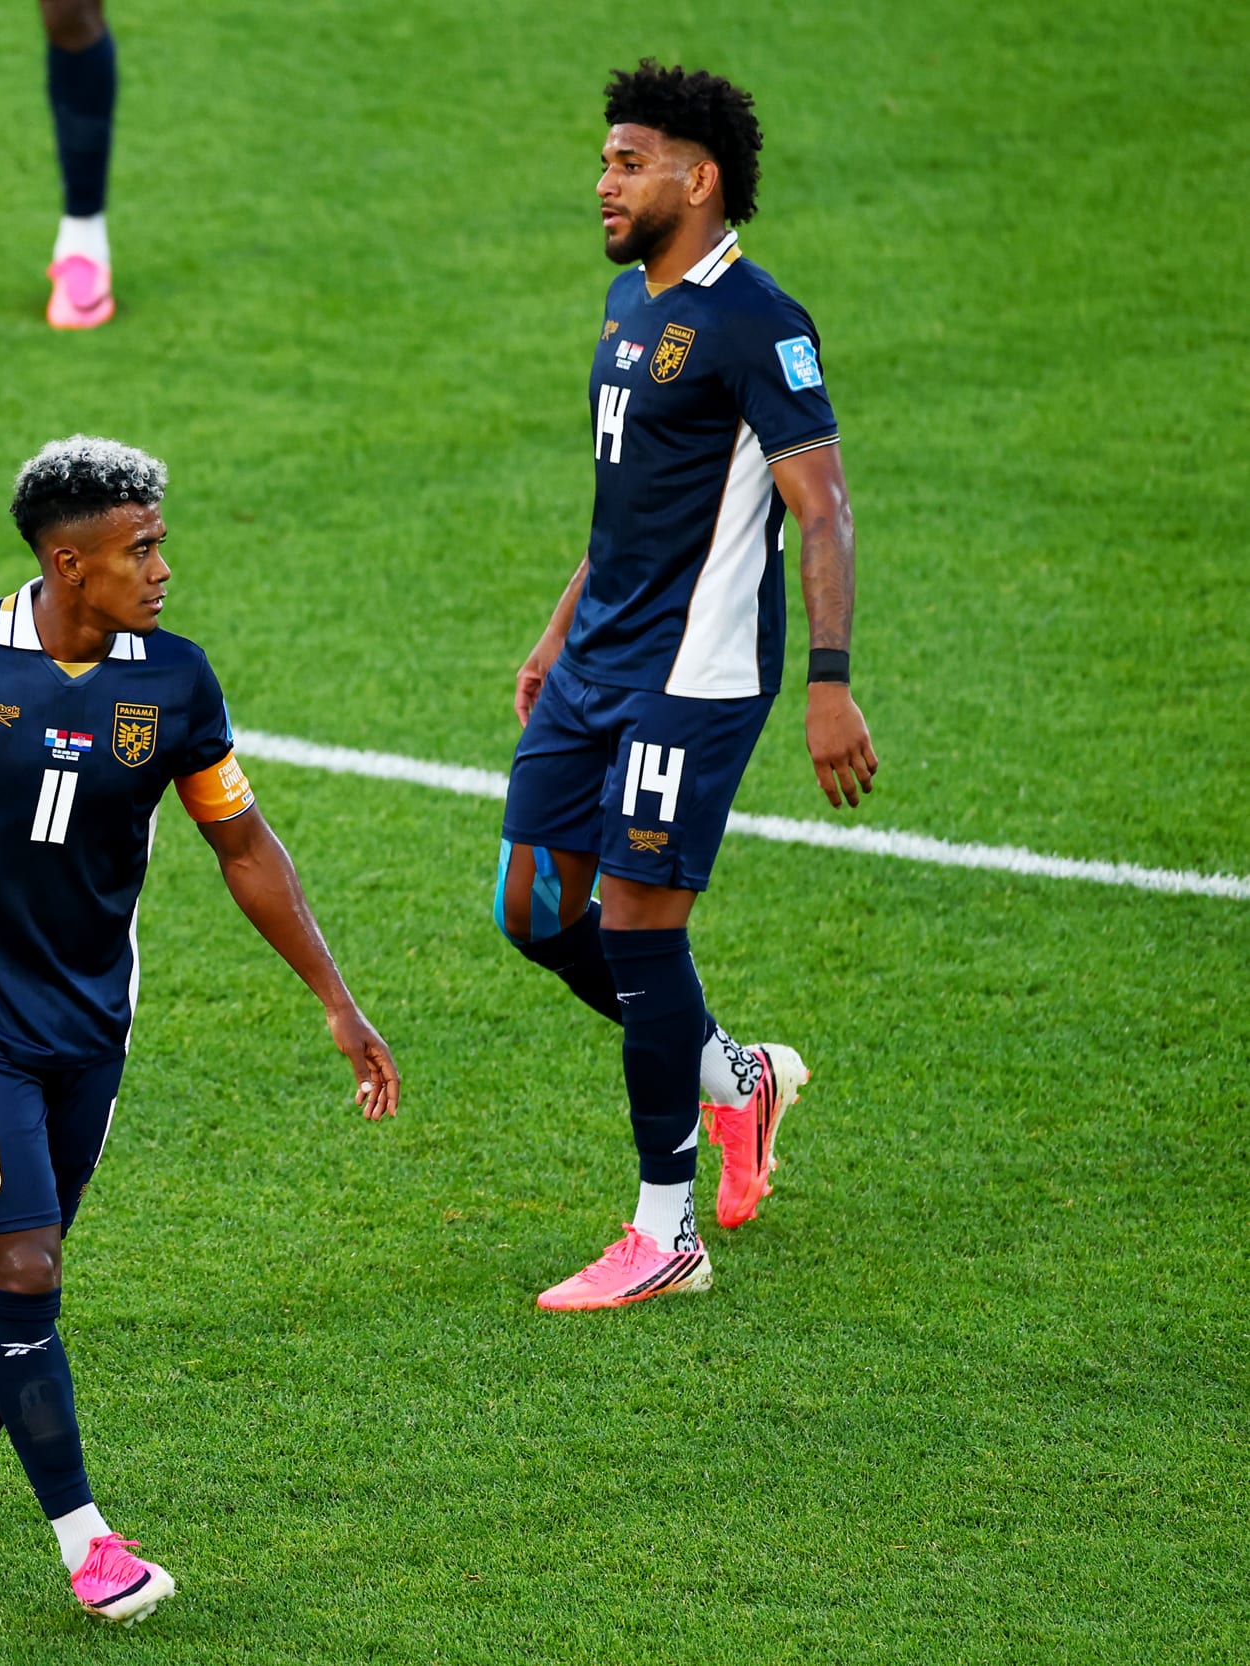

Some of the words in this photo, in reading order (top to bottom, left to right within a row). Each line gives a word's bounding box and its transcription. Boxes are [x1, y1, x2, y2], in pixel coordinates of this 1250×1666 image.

[595, 384, 631, 464] 14
[30, 769, 79, 845] 11
[622, 741, 686, 822] 14
[628, 828, 668, 841] Reebok
